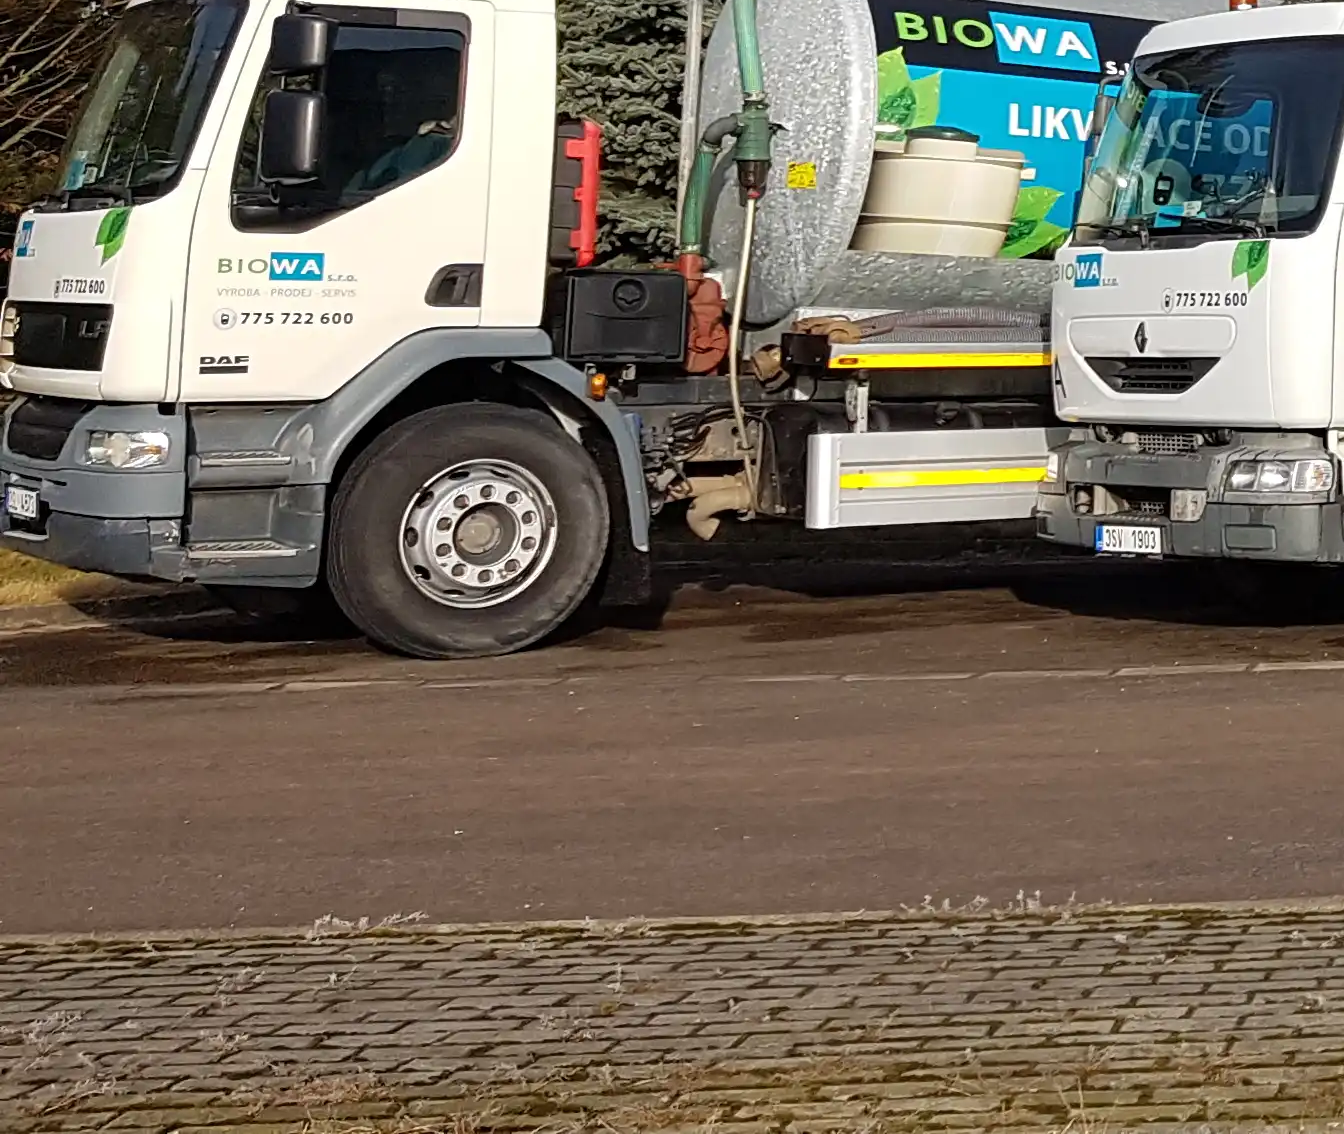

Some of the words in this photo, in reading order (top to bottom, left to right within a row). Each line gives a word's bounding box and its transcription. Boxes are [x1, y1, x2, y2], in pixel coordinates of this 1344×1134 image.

[894, 11, 1093, 60] BIOWA
[217, 258, 321, 275] BIOWA
[327, 274, 357, 282] s.r.o.
[89, 279, 105, 295] 600
[270, 288, 312, 297] PRODEJ
[1176, 293, 1196, 307] 775
[1200, 293, 1221, 307] 722
[1225, 293, 1248, 307] 600
[240, 312, 274, 325] 775
[281, 312, 314, 325] 722
[320, 312, 354, 325] 600
[200, 356, 249, 365] DAF
[1105, 529, 1123, 548] 3SV
[1132, 530, 1156, 549] 1903
